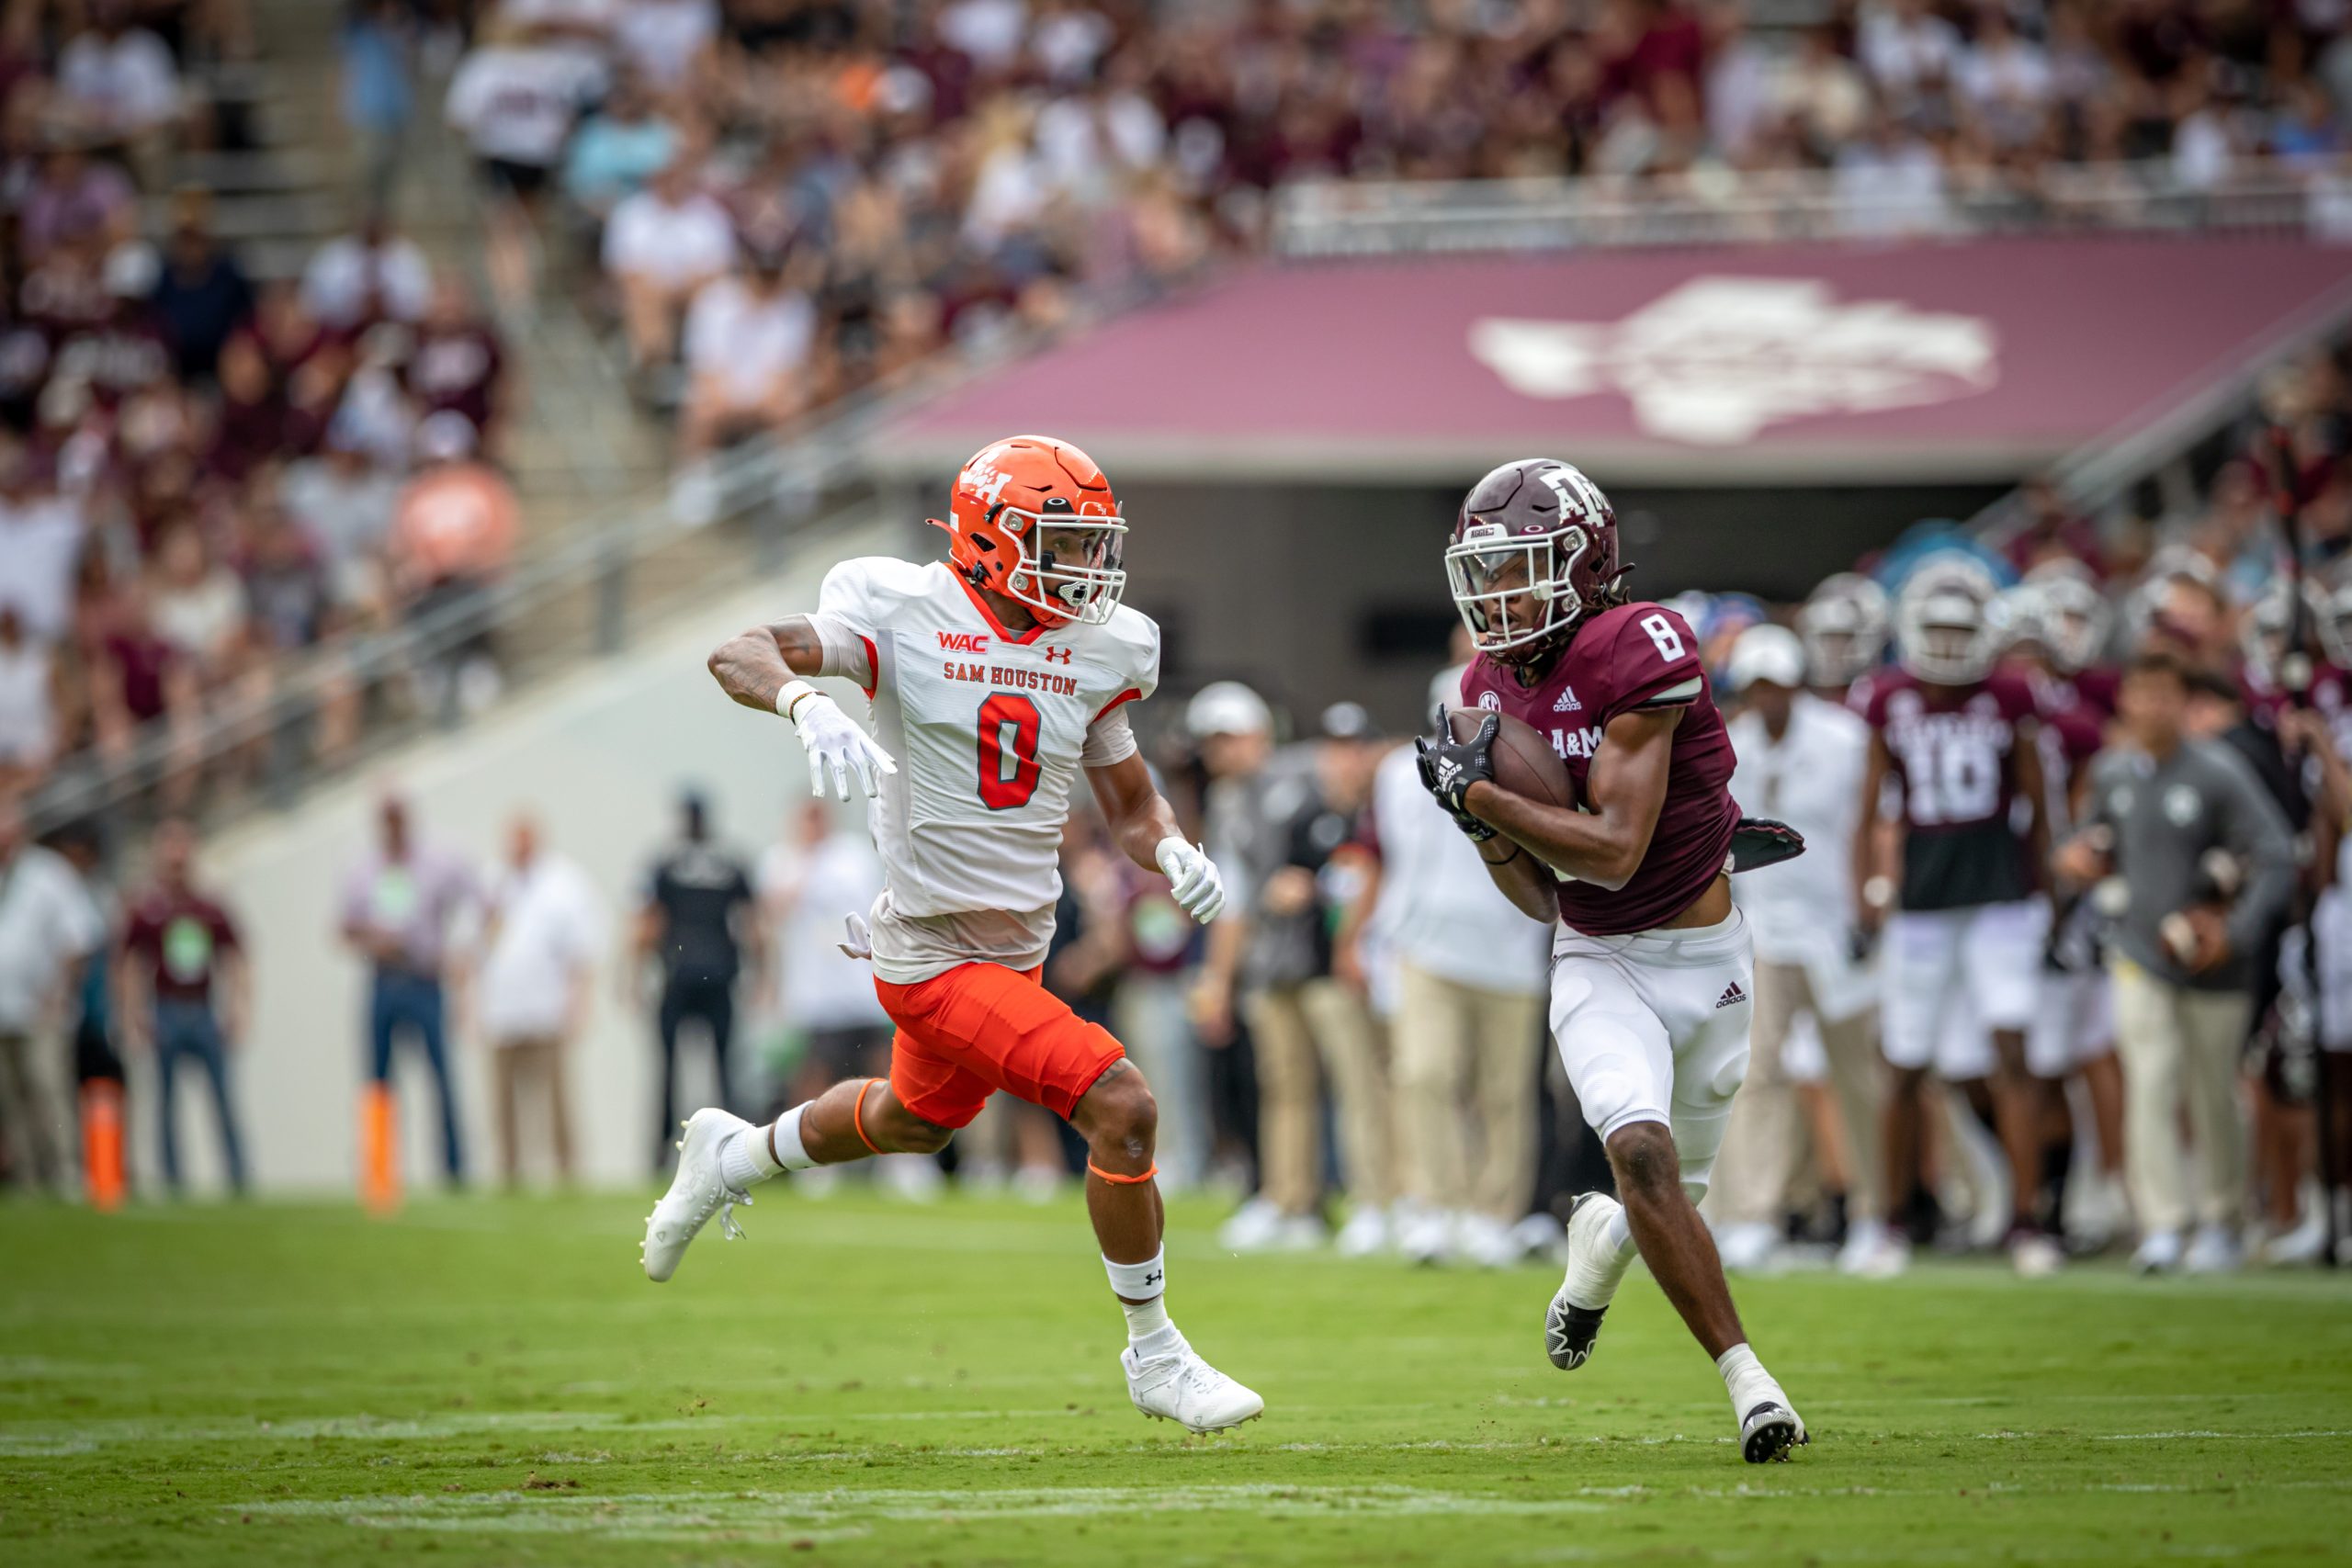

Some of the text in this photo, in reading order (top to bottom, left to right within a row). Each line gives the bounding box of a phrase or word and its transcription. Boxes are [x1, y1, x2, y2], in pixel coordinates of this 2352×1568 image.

[937, 631, 989, 653] WAC
[1640, 613, 1686, 662] 8
[944, 661, 1078, 696] SAM HOUSTON
[1553, 701, 1582, 712] adidas
[977, 691, 1043, 811] 0
[1715, 993, 1747, 1009] adidas
